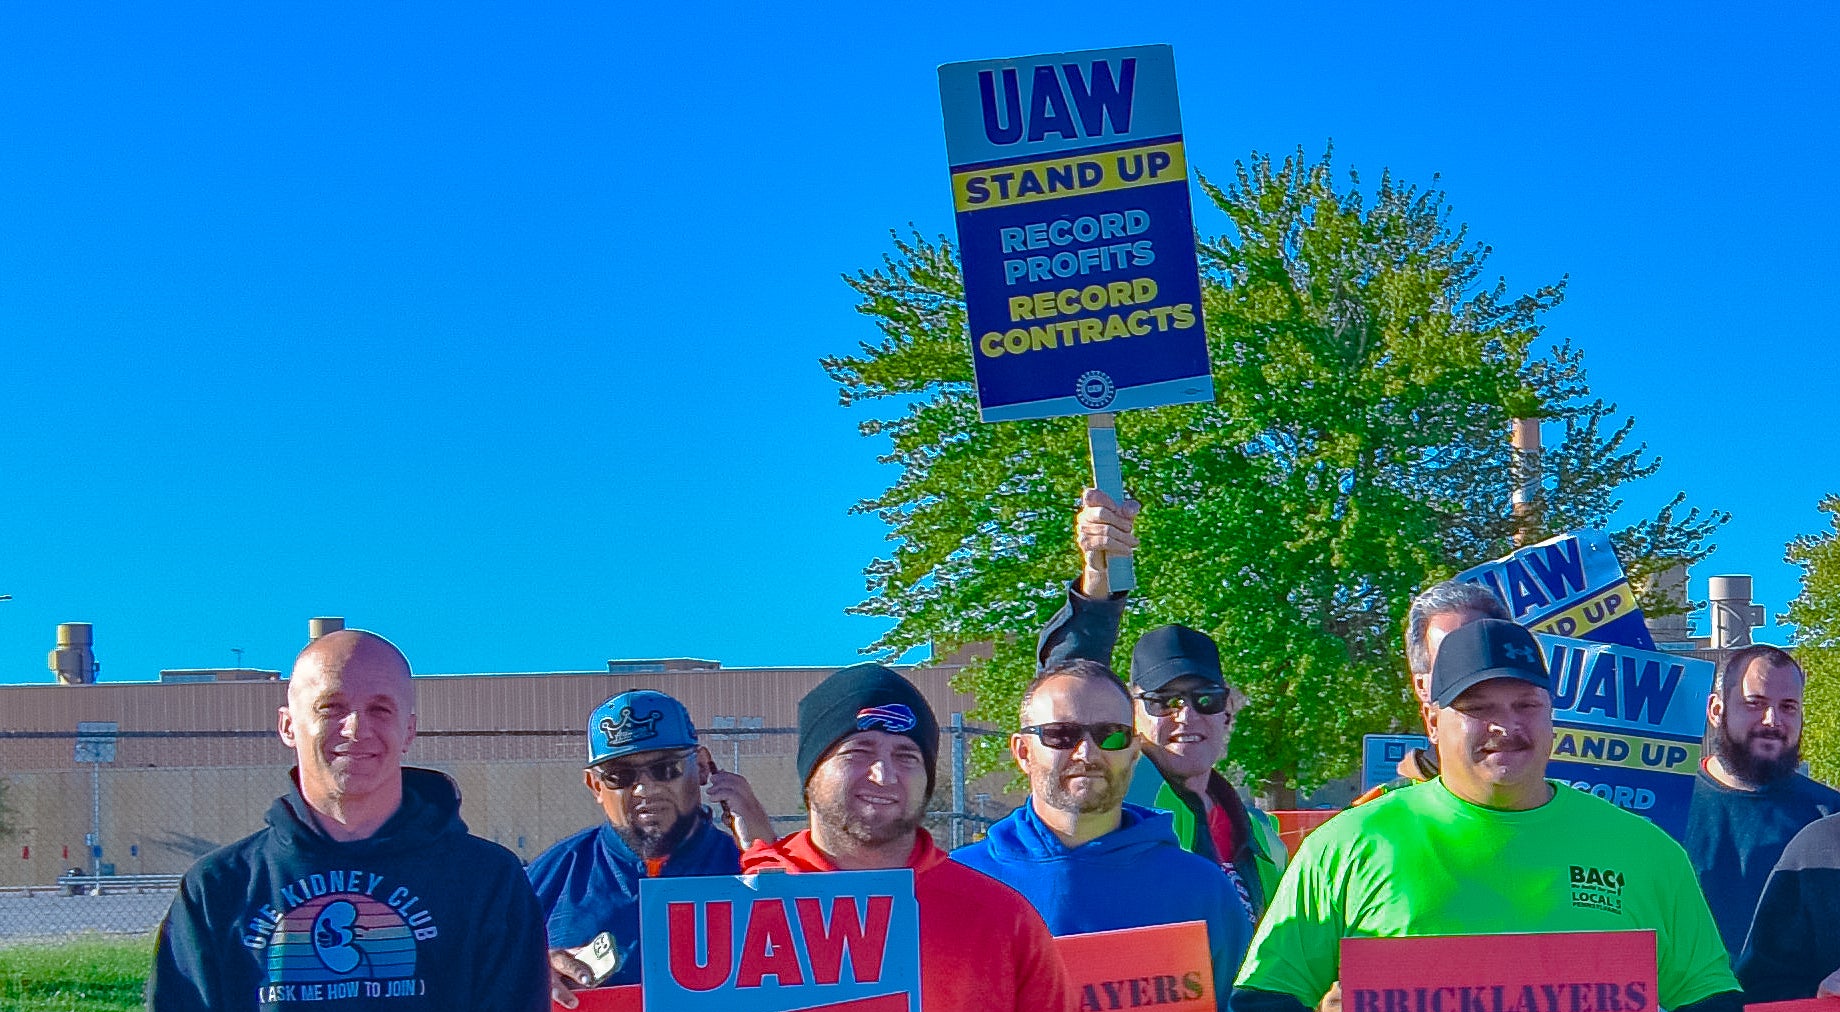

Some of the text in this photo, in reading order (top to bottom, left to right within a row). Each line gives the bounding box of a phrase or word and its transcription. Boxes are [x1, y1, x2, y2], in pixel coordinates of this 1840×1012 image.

[978, 58, 1137, 145] UAW
[964, 152, 1171, 204] STAND UP
[1000, 209, 1151, 253] RECORD
[1004, 240, 1155, 285] PROFITS
[1008, 277, 1158, 321] RECORD
[980, 304, 1195, 358] CONTRACTS
[1583, 594, 1622, 623] UP
[1552, 645, 1684, 725] UAW
[1641, 744, 1687, 768] UP
[243, 870, 438, 949] ONE KIDNEY CLUB
[1572, 892, 1613, 906] LOCAL
[666, 894, 894, 992] UAW
[302, 984, 323, 1000] ME
[327, 982, 359, 999] HOW
[364, 982, 380, 997] TO
